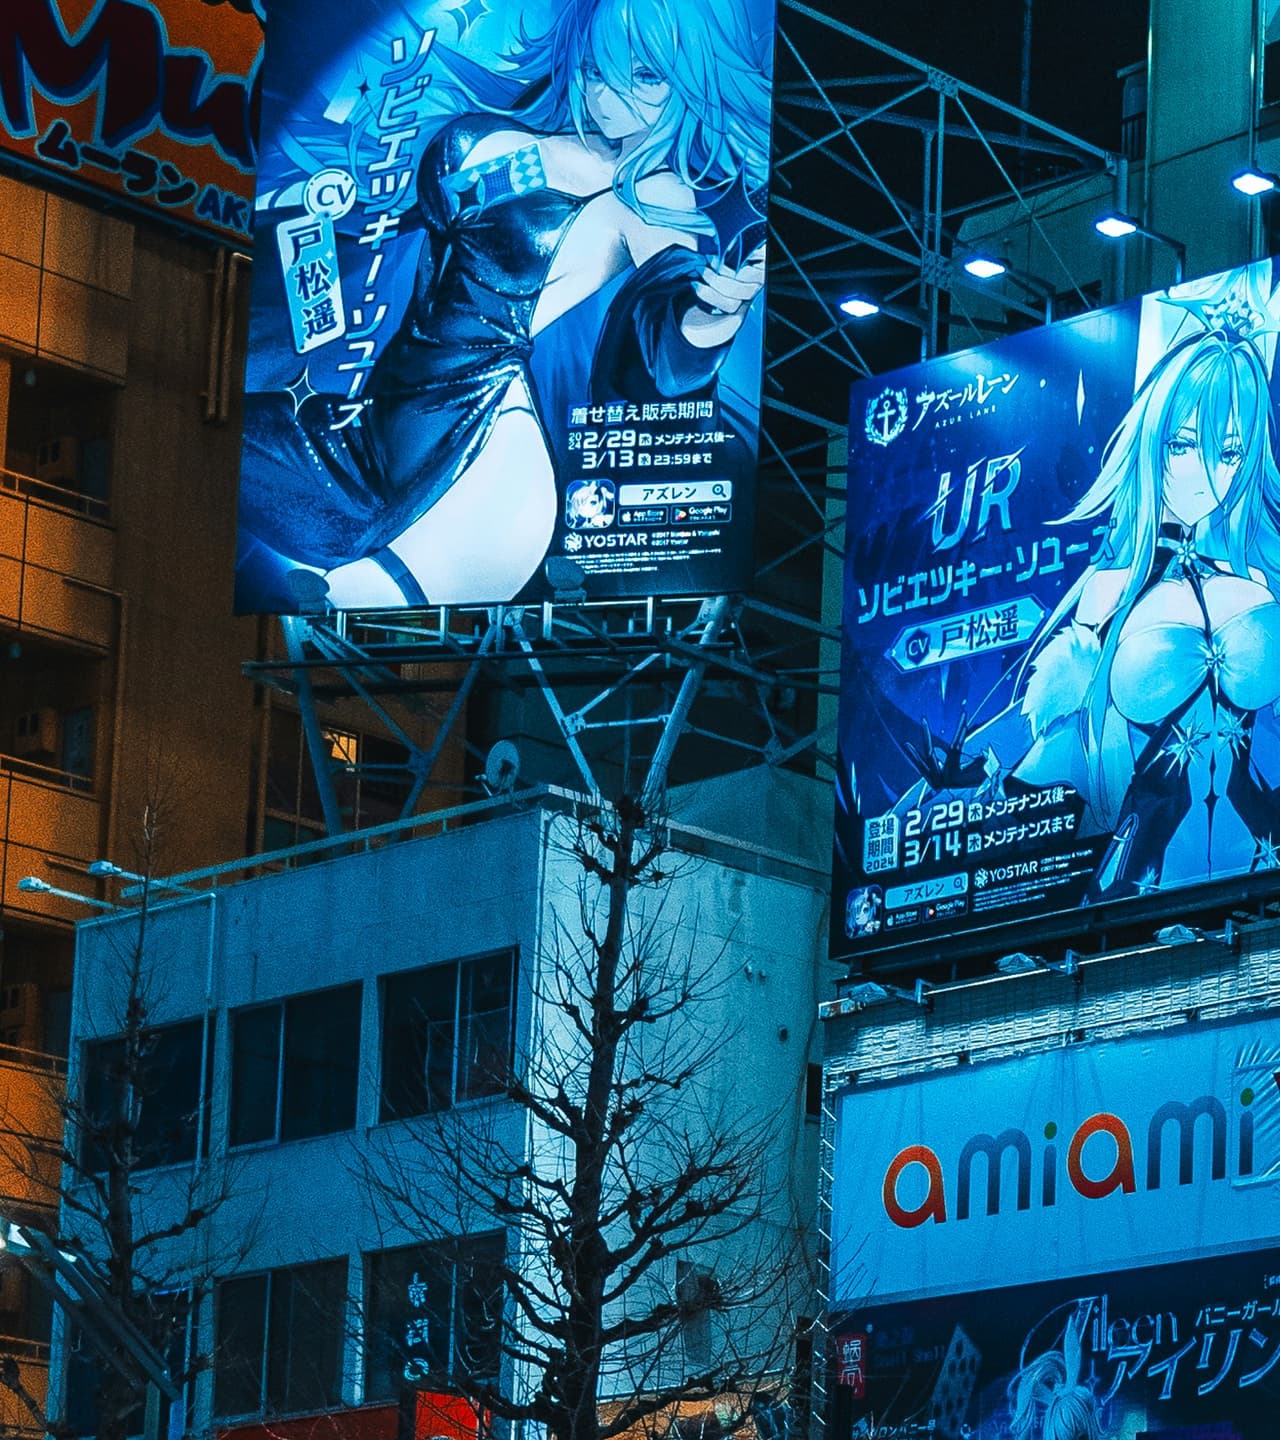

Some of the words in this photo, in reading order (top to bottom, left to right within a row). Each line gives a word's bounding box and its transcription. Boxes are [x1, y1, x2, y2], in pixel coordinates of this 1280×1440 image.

[316, 183, 355, 207] CV
[287, 222, 338, 339] 戸松遥
[583, 430, 636, 449] 2/29
[582, 450, 635, 469] 3/13
[643, 487, 697, 500] アズレン
[930, 448, 1024, 553] UR
[584, 533, 648, 547] YOSTAR
[938, 604, 1018, 659] 戸松遥
[907, 636, 929, 657] CV
[905, 800, 964, 837] 2/29
[903, 831, 961, 868] 3/14
[866, 859, 895, 872] 2024
[989, 862, 1038, 882] YOSTAR
[882, 1087, 1255, 1229] amiami
